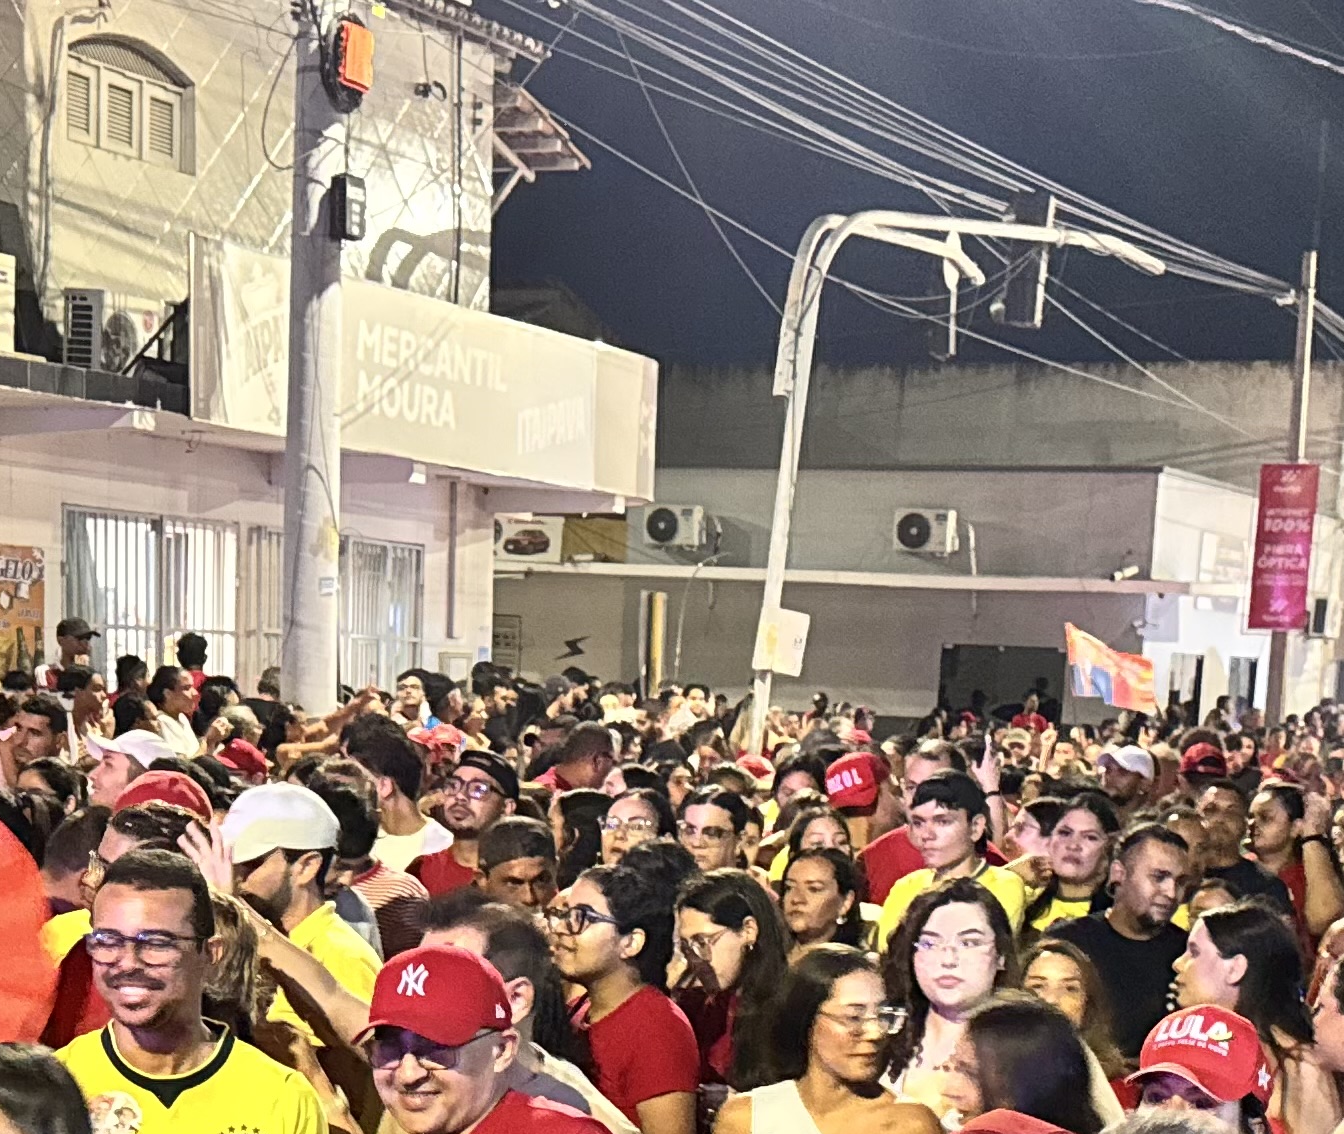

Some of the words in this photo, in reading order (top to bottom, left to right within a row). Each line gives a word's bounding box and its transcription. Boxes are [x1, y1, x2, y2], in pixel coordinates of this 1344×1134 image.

[356, 319, 507, 392] MERCANTIL
[356, 369, 455, 430] MOURA
[1263, 518, 1311, 533] 100%
[396, 963, 429, 996] NY
[1154, 1014, 1233, 1050] LULA
